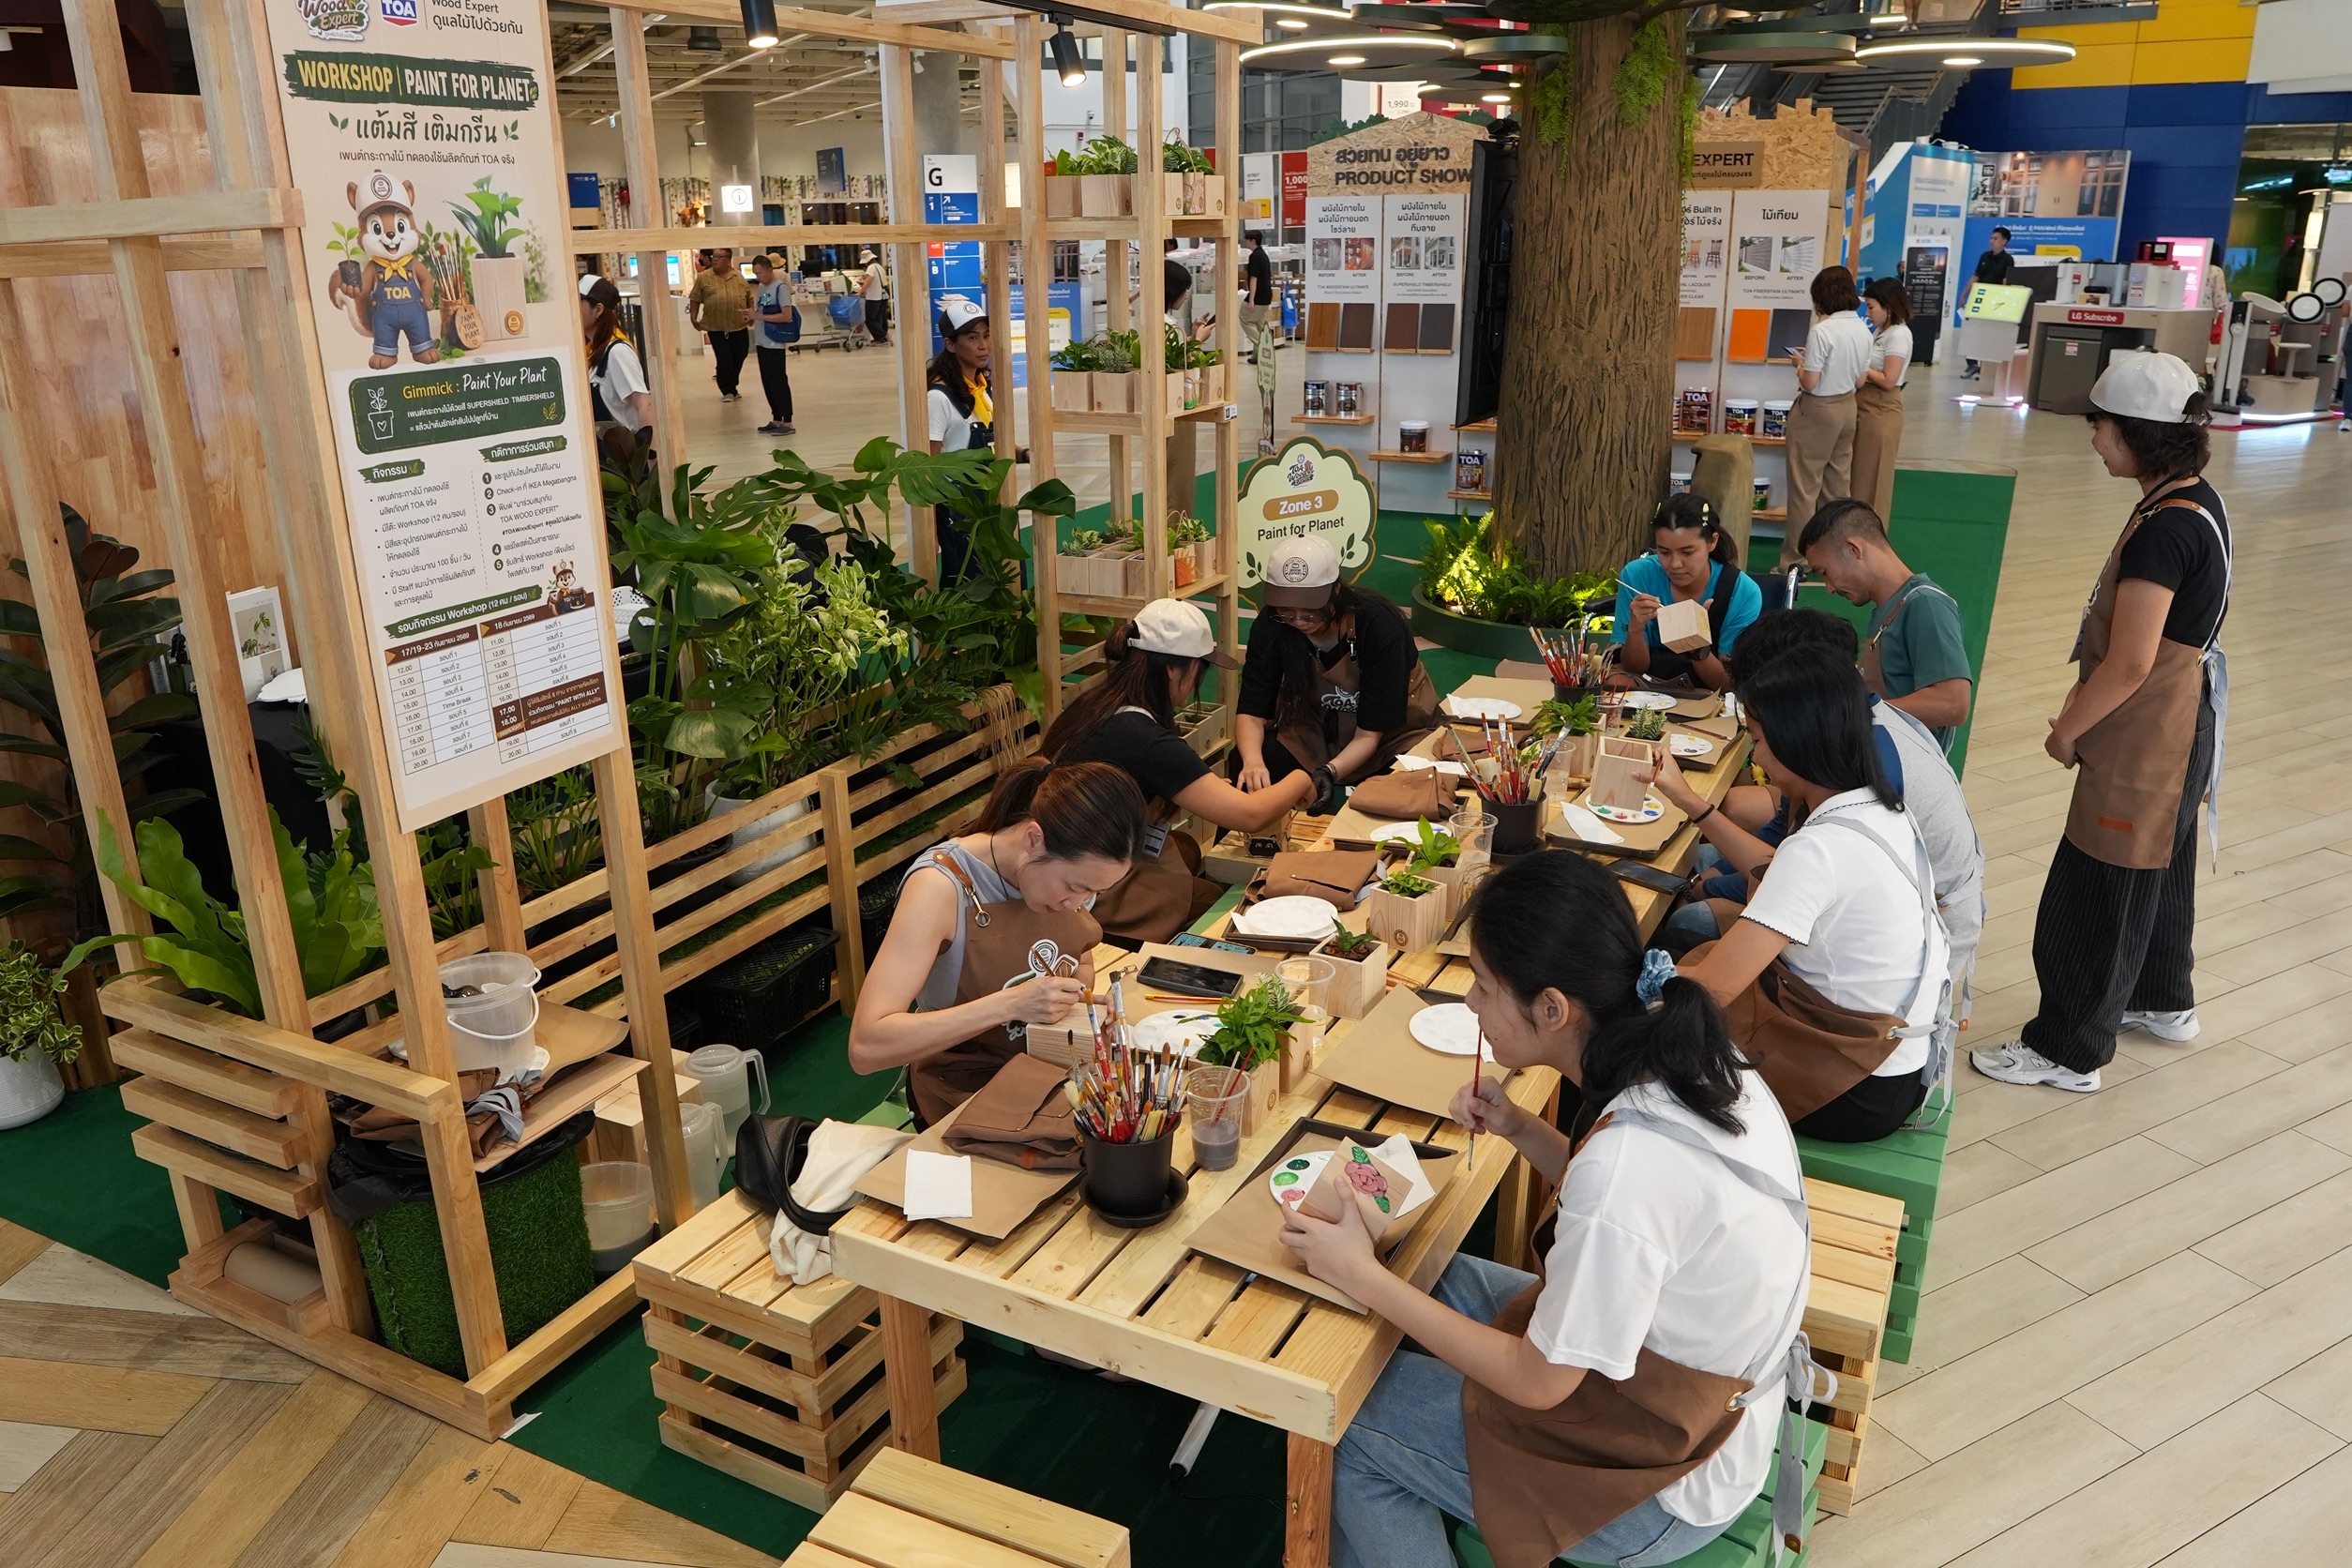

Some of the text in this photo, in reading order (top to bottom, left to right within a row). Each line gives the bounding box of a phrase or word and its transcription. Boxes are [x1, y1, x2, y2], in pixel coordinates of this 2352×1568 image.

[383, 0, 415, 17] TOA
[465, 0, 499, 14] Expert
[320, 12, 358, 29] Expert
[433, 14, 522, 35] ดูแลไม้ไปด้วยกัน
[297, 59, 531, 101] WORKSHOP PAINT FOR PLANET
[356, 110, 497, 143] แต้มสี เติมกรีน
[339, 150, 515, 165] เพนต์กระถางไม้ ทดลองใช้ผลิตภัณฑ์ TOA จริง
[1335, 141, 1450, 169] สวยทน อยู่ยาว
[1694, 153, 1754, 166] EXPERT
[928, 167, 942, 187] G
[1334, 170, 1418, 186] PRODUCT
[928, 202, 934, 210] 1
[1321, 204, 1365, 213] ผนังไม้ภายใน
[1401, 202, 1447, 211] ผนังไม้ภายใน
[1319, 214, 1369, 224] ผนังไม้ภายนอก
[1397, 212, 1450, 222] ผนังไม้ภายนอก
[1761, 208, 1799, 220] ไม้เทียม
[1331, 224, 1356, 234] โชว์ลาย
[1410, 223, 1436, 233] ทึบลาย
[931, 266, 939, 275] B
[384, 286, 411, 299] TOA
[2083, 312, 2118, 322] Subscribe
[462, 322, 477, 331] YOUR
[464, 329, 481, 339] PLANT
[402, 366, 547, 400] Gimmick Paint Your Plant
[1685, 393, 1708, 402] TOA
[407, 391, 555, 418] เพนต์กระถางไม้ด้วยสี SUPERSHIELD TIMBERSHIELD
[490, 440, 554, 459] กติกาการร่วมสนุก
[1459, 456, 1480, 464] TOA
[372, 464, 407, 479] กิจกรรม
[497, 483, 522, 495] Check-in
[543, 475, 577, 487] Megabangna
[377, 481, 450, 502] เพนต์กระถางไม้ ทดลองใช้
[411, 501, 425, 510] TOA
[1279, 495, 1323, 515] Zone 3
[514, 511, 534, 520] WOOD
[398, 517, 430, 530] Workshop
[431, 514, 441, 524] (12
[1258, 516, 1345, 541] Paint for Planet
[525, 550, 553, 561] Workshop
[437, 557, 449, 566] 100
[530, 563, 545, 573] Staff
[398, 582, 414, 594] Staff
[398, 614, 446, 634] รอบกิจกรรม
[446, 602, 488, 620] Workshop
[489, 600, 498, 611] (12
[494, 622, 503, 630] 18
[400, 640, 433, 657] 17/19-23
[397, 665, 413, 674] 12.00
[400, 676, 415, 686] 13.00
[401, 688, 416, 698] 14.00
[572, 693, 586, 701] WITH
[403, 701, 418, 710] 15.00
[442, 696, 472, 710] Time Break
[499, 705, 516, 716] 17.00
[405, 713, 421, 722] 16.00
[501, 716, 517, 727] 18.00
[407, 724, 423, 733] 17.00
[409, 736, 425, 746] 18.00
[506, 737, 520, 746] 19.00
[411, 747, 427, 758] 19.00
[507, 749, 521, 759] 20.00
[414, 760, 429, 769] 20.00
